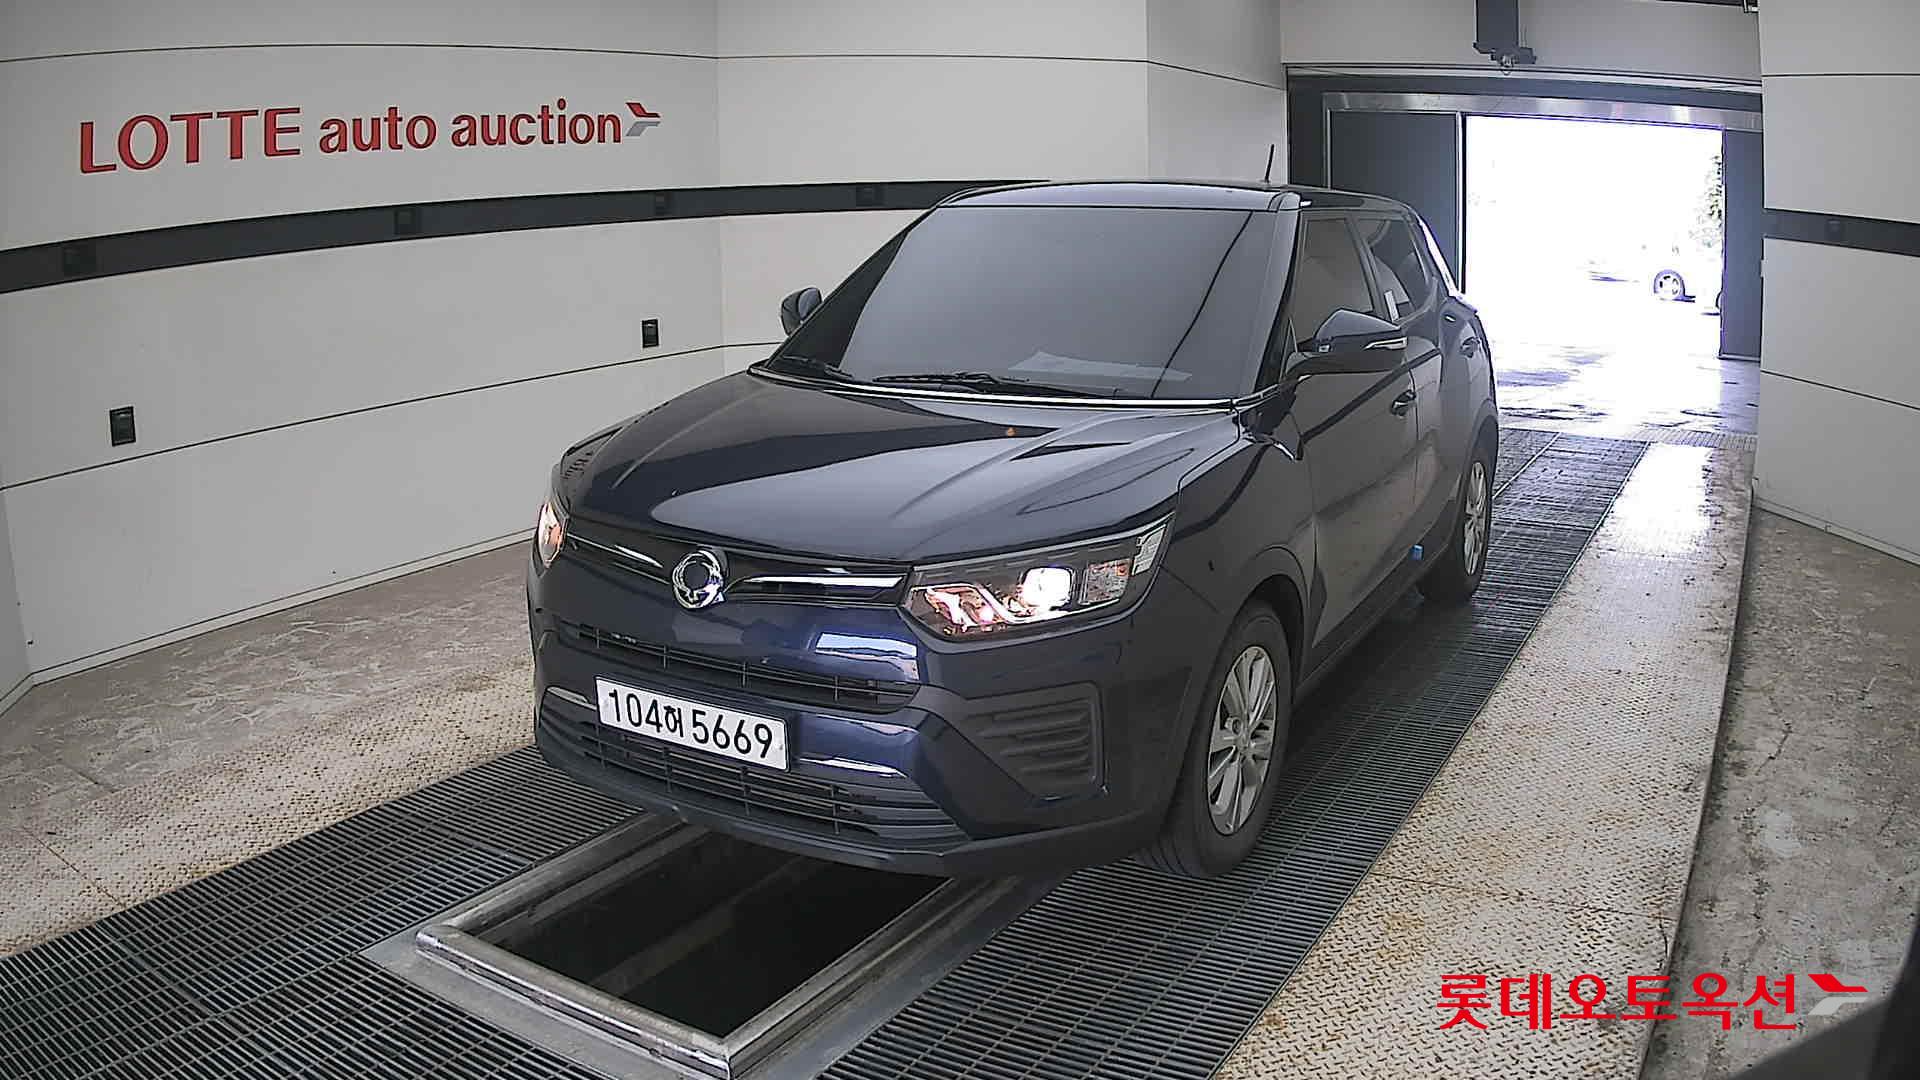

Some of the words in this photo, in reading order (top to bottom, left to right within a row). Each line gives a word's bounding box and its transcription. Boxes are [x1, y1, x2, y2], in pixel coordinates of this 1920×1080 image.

[79, 106, 301, 174] LOTTE
[319, 105, 437, 153] auto
[451, 98, 623, 146] auction
[608, 689, 684, 738] 104허
[692, 710, 773, 759] 5669
